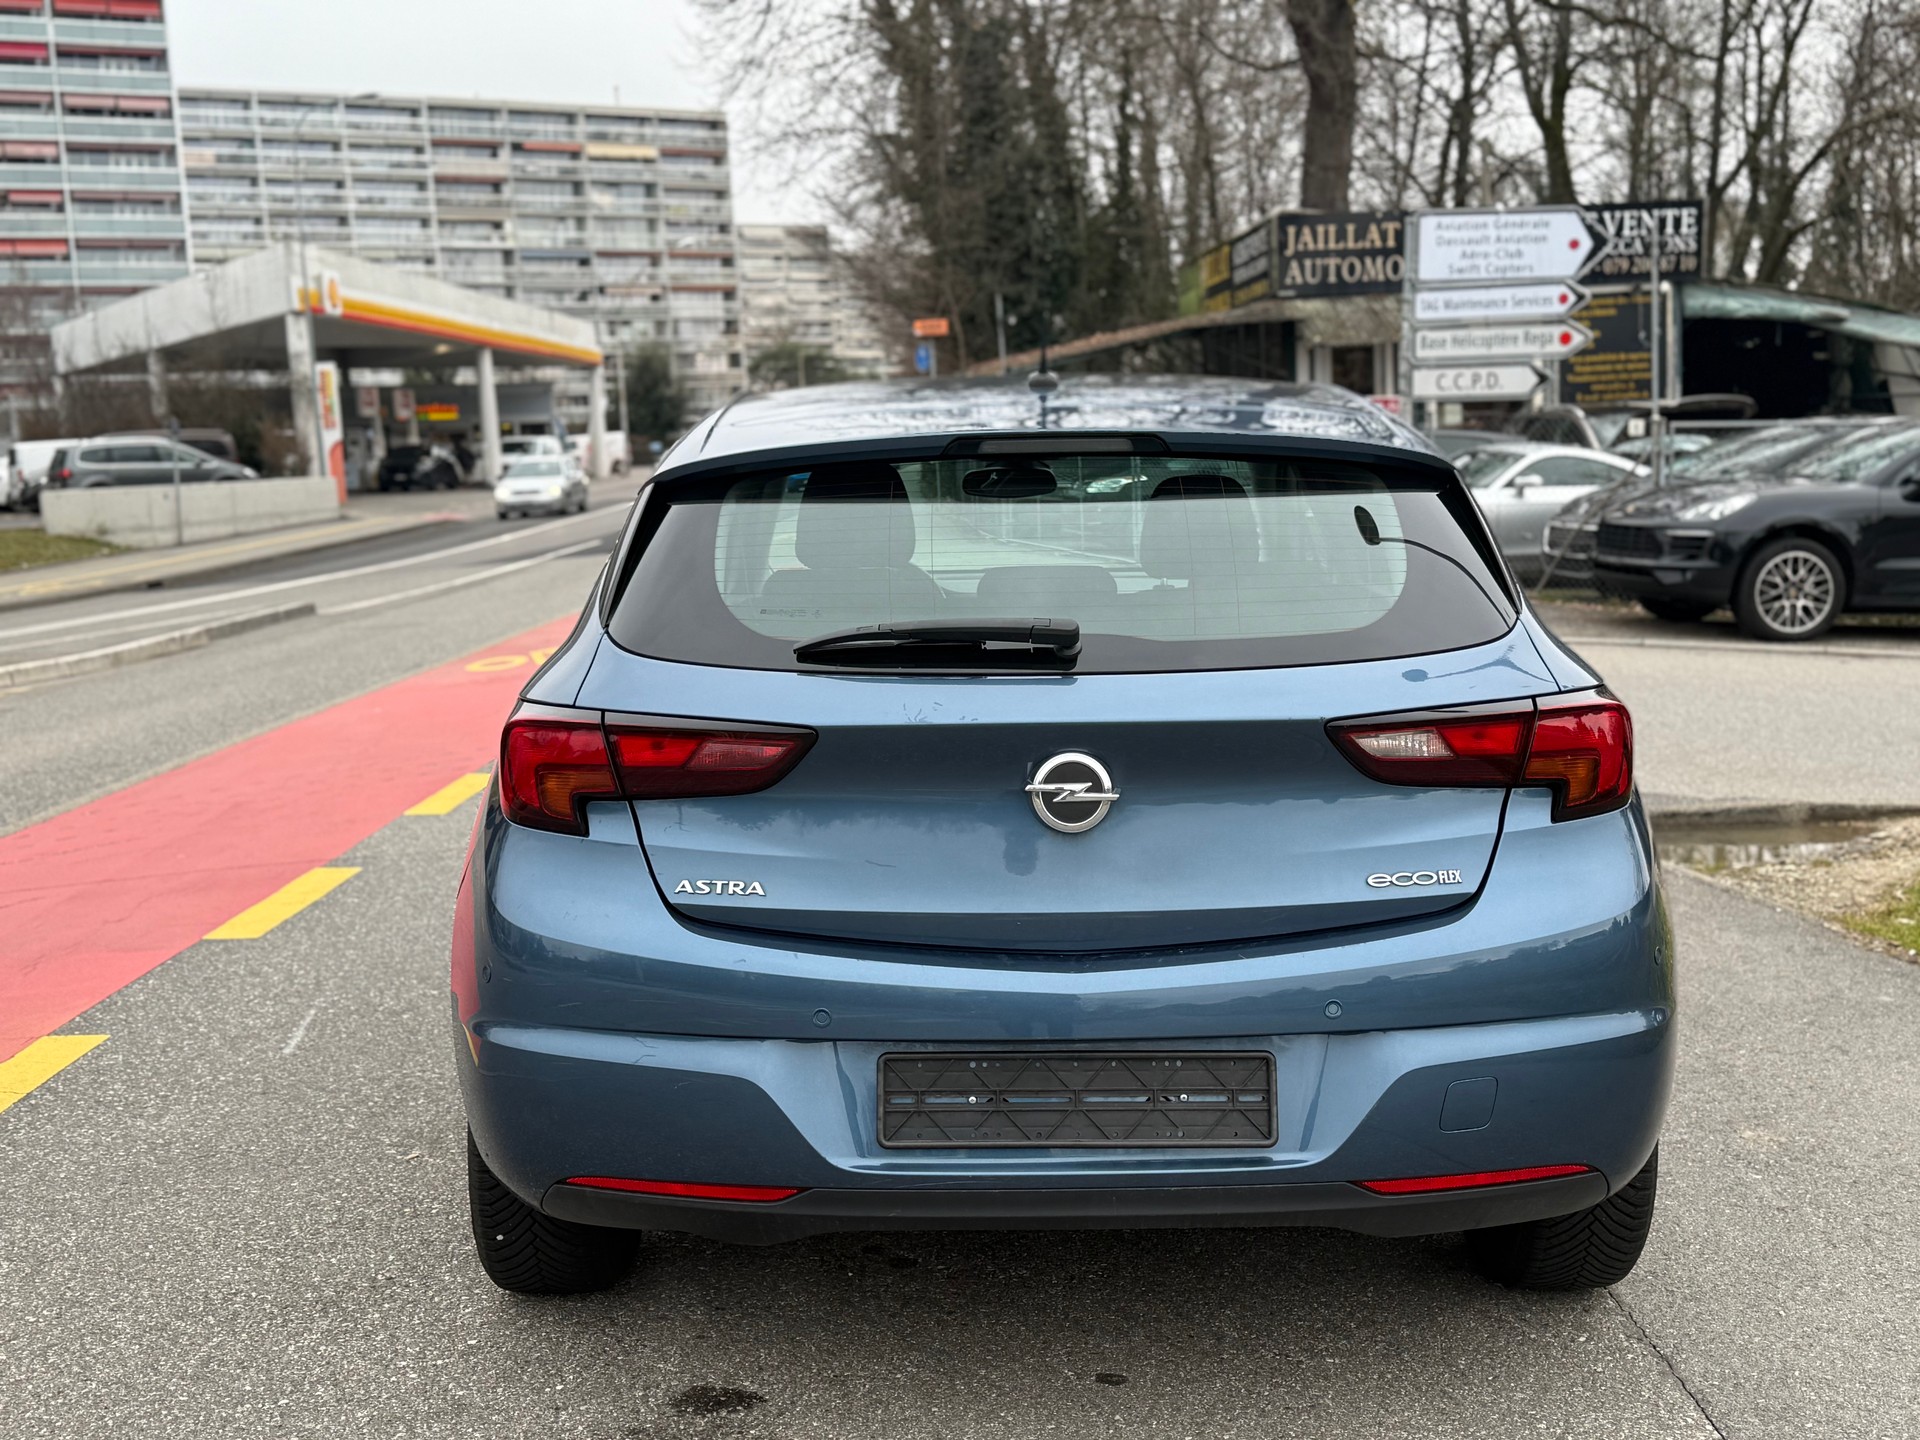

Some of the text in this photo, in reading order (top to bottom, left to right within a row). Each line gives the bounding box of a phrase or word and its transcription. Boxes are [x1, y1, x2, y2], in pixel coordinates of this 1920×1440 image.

[1602, 207, 1698, 236] VENTE
[1283, 222, 1402, 257] JAILLAT
[1284, 254, 1405, 285] AUTOMO
[1420, 334, 1447, 350] Base
[1436, 371, 1504, 392] C.C.P.D.
[674, 879, 766, 896] ASTRA
